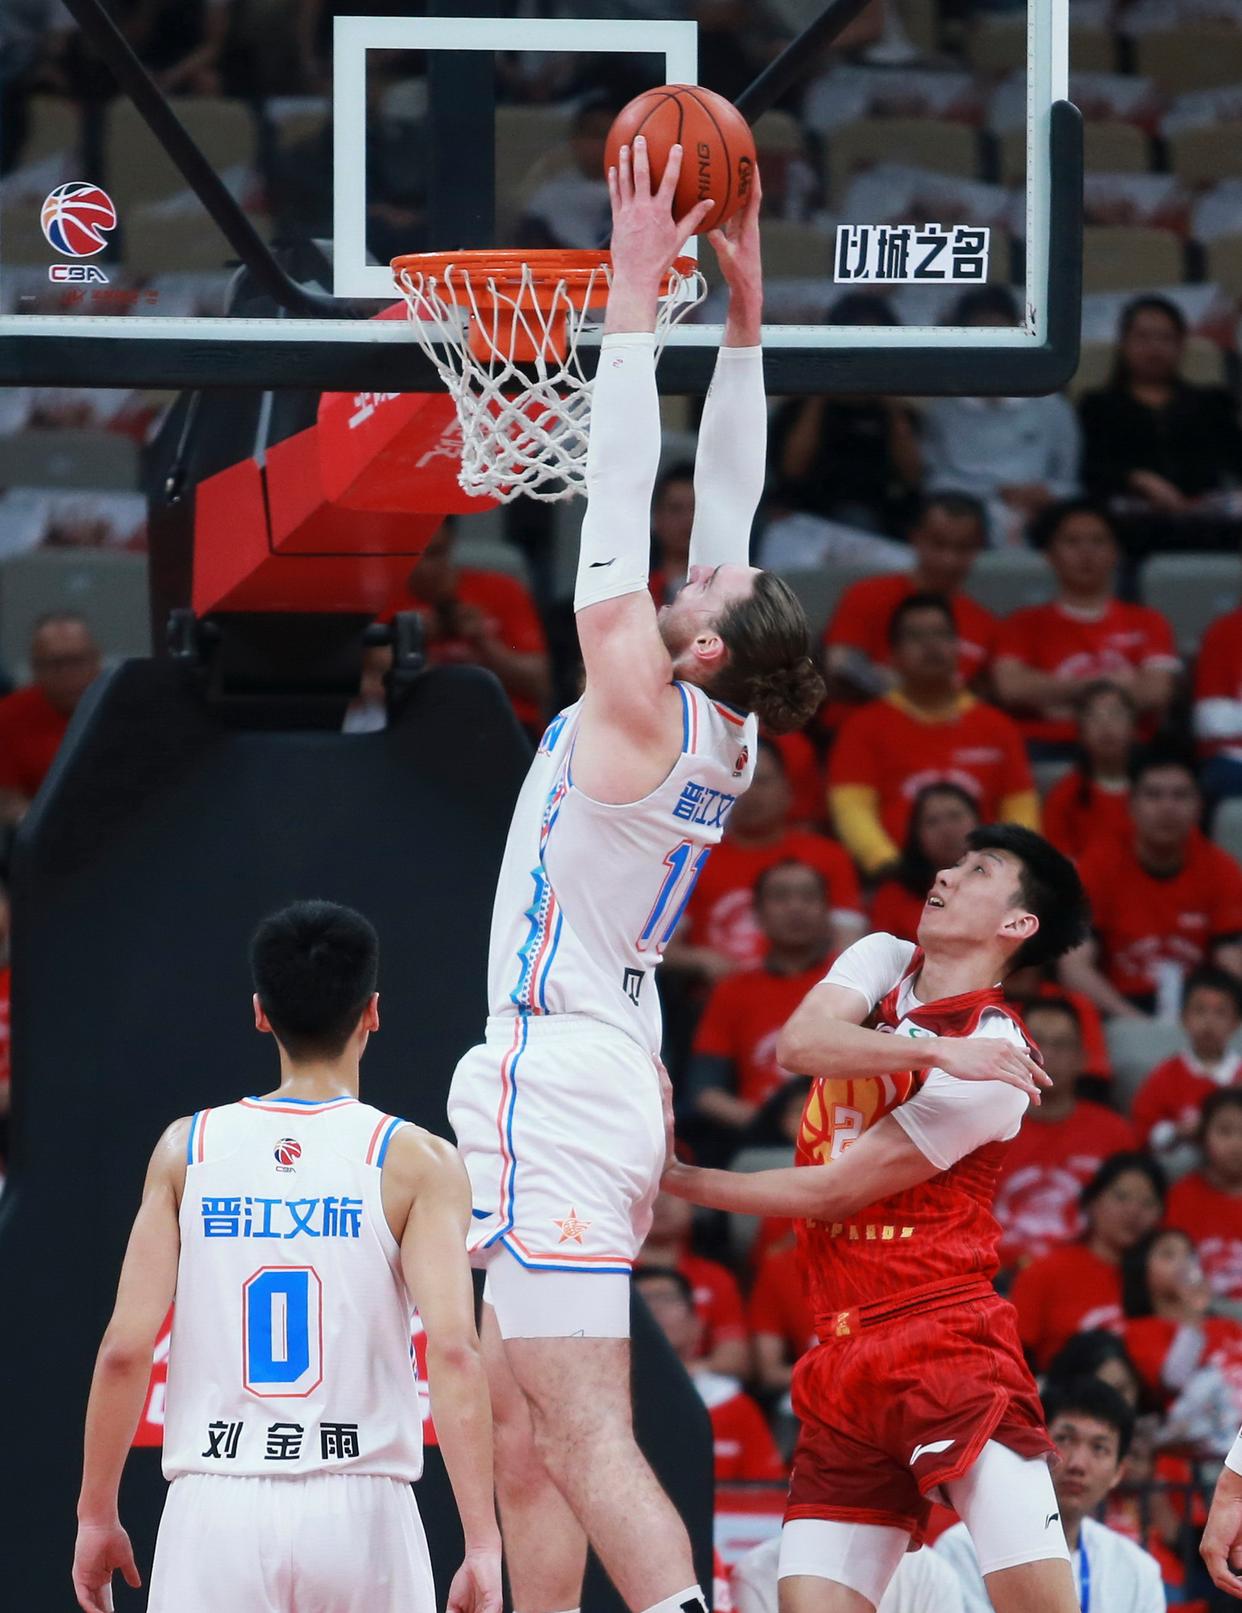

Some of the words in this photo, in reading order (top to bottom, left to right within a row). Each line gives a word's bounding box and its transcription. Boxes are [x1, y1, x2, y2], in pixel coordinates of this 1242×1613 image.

[49, 265, 109, 283] CBA
[837, 226, 986, 279] 以城之名
[636, 839, 712, 954] 11
[275, 1165, 297, 1174] CBA
[201, 1196, 364, 1239] 晋江文旅
[242, 1266, 323, 1398] 0
[201, 1420, 360, 1460] 刘金雨
